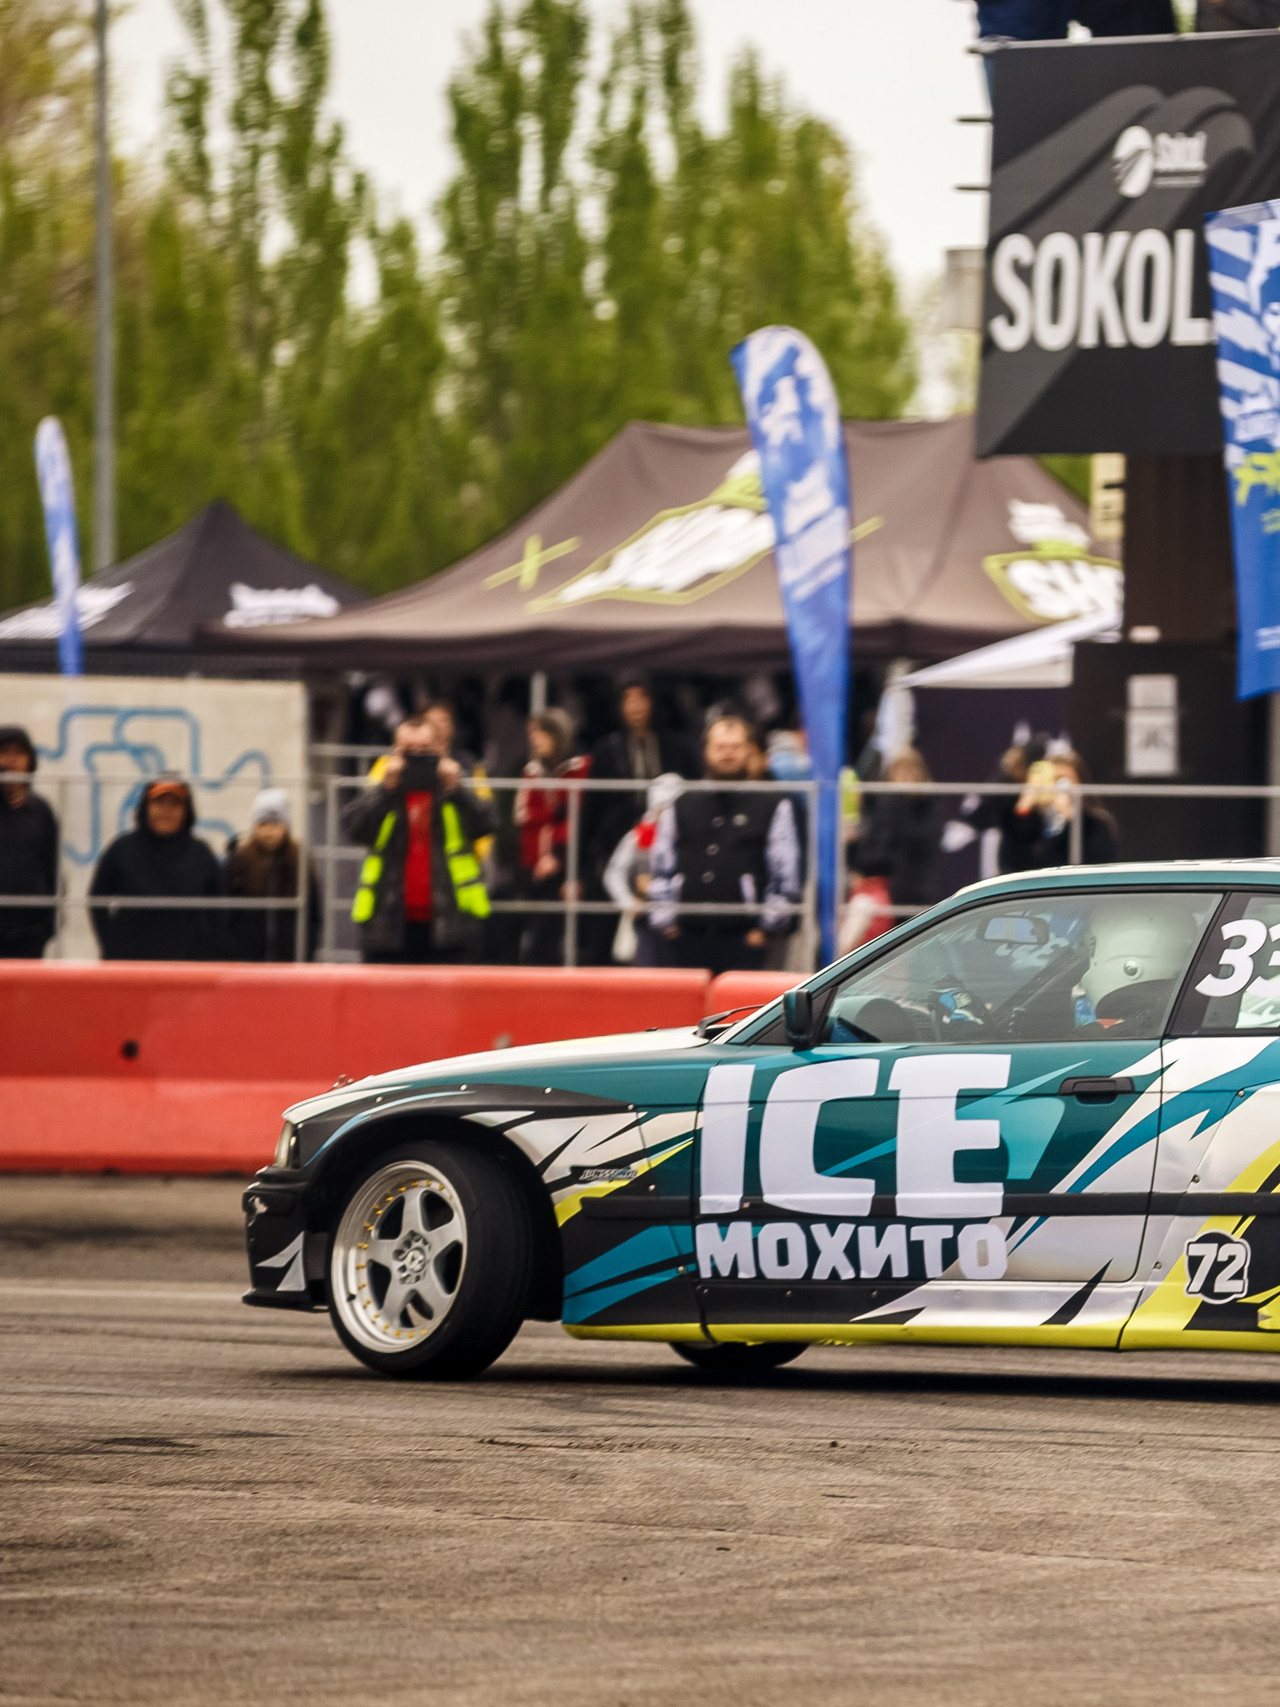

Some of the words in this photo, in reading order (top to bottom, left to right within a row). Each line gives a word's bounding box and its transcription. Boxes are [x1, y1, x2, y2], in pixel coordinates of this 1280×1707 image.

[989, 228, 1214, 352] SOKOL
[700, 1053, 1011, 1218] ICE
[696, 1220, 1008, 1281] МОХИТО
[1187, 1242, 1248, 1294] 72
